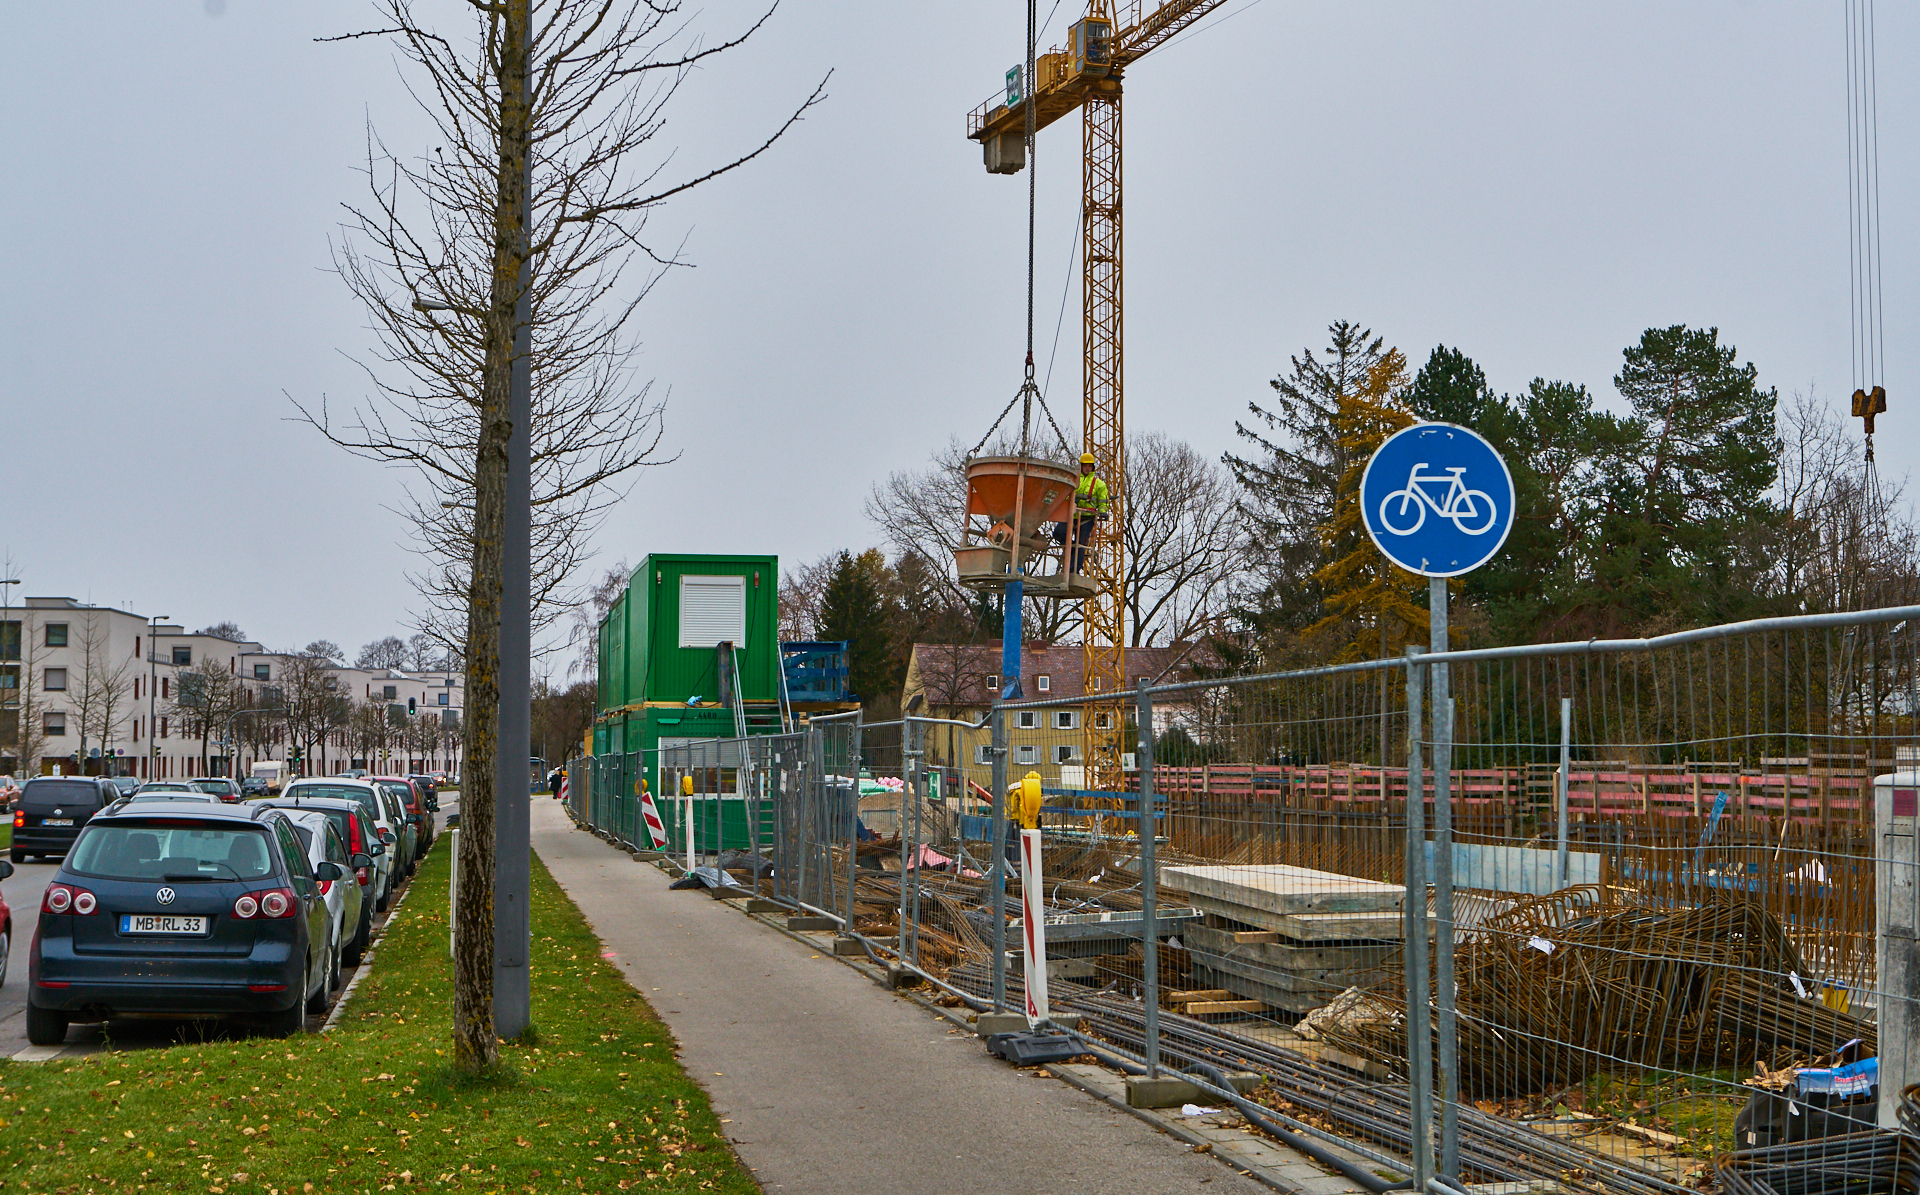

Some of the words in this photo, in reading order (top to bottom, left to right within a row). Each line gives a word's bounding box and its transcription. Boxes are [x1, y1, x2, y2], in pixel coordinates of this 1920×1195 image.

[135, 917, 154, 931] MB
[162, 918, 180, 931] RL
[183, 918, 201, 932] 33
